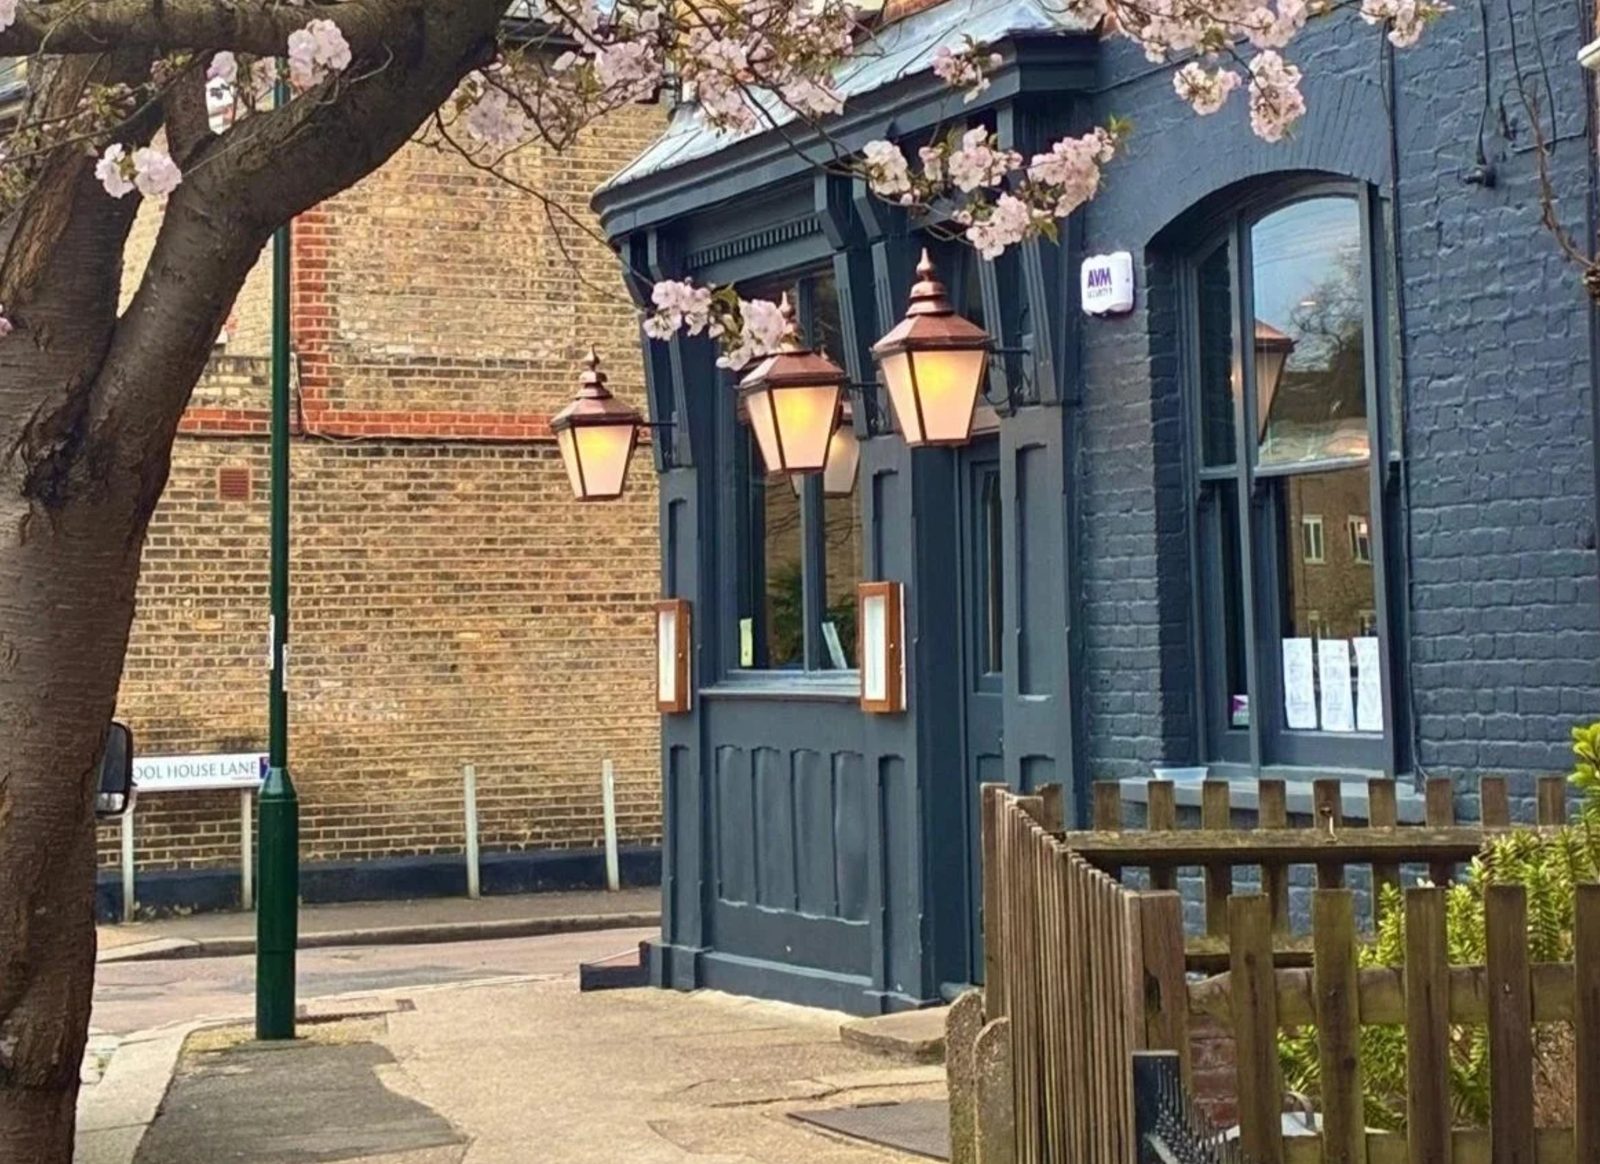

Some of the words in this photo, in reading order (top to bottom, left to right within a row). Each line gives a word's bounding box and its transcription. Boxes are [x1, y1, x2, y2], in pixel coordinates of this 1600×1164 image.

[1088, 267, 1112, 288] AVM
[167, 762, 217, 778] HOUSE
[221, 760, 257, 776] LANE
